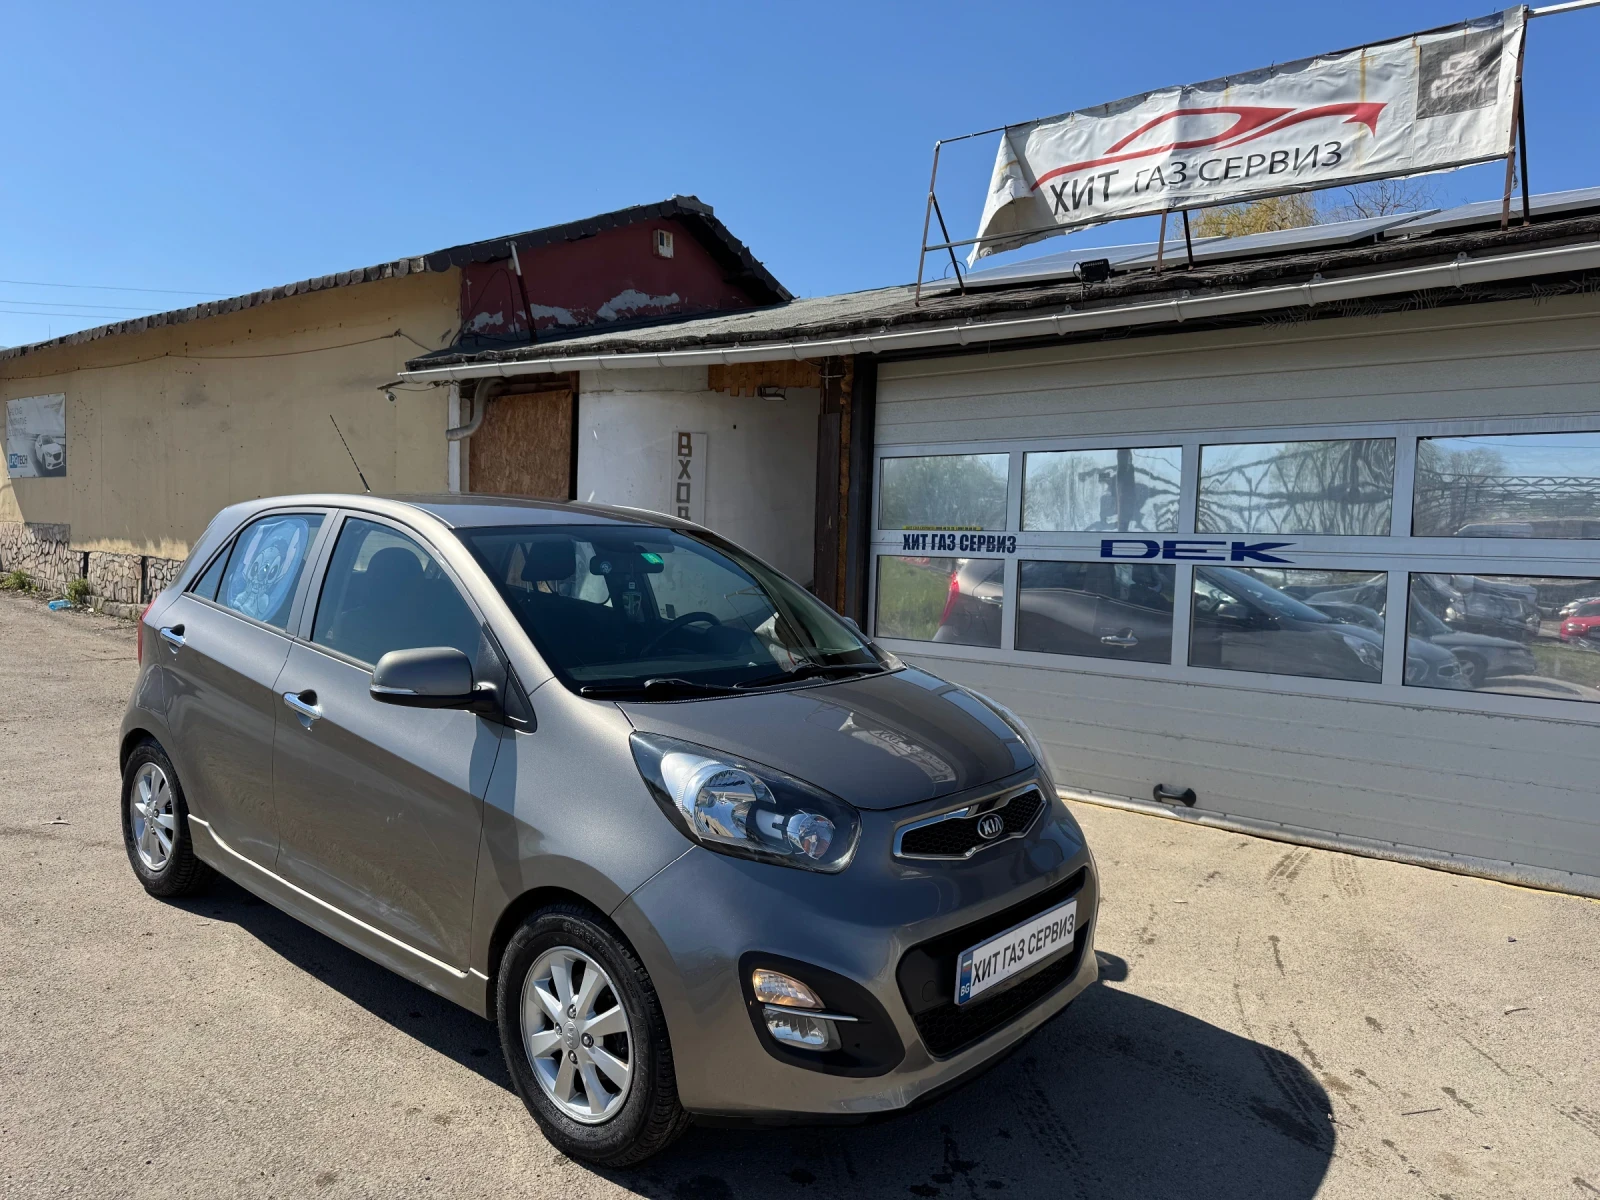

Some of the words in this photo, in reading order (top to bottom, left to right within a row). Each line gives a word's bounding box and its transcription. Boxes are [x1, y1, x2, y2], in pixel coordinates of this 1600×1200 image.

[1050, 169, 1119, 215] ХИТ
[1134, 161, 1187, 193] ГАЗ
[1199, 141, 1342, 183] СЕРВИЗ
[903, 534, 928, 551] ХИТ
[931, 534, 956, 551] ГАЗ
[960, 534, 1017, 553] СЕРВИЗ
[1100, 540, 1297, 564] DEK
[981, 817, 1001, 835] KIA
[972, 951, 1000, 986] ХИТ
[1002, 938, 1025, 970] ГАЗ
[1028, 913, 1074, 955] СЕРВИЗ
[960, 983, 970, 996] BG
